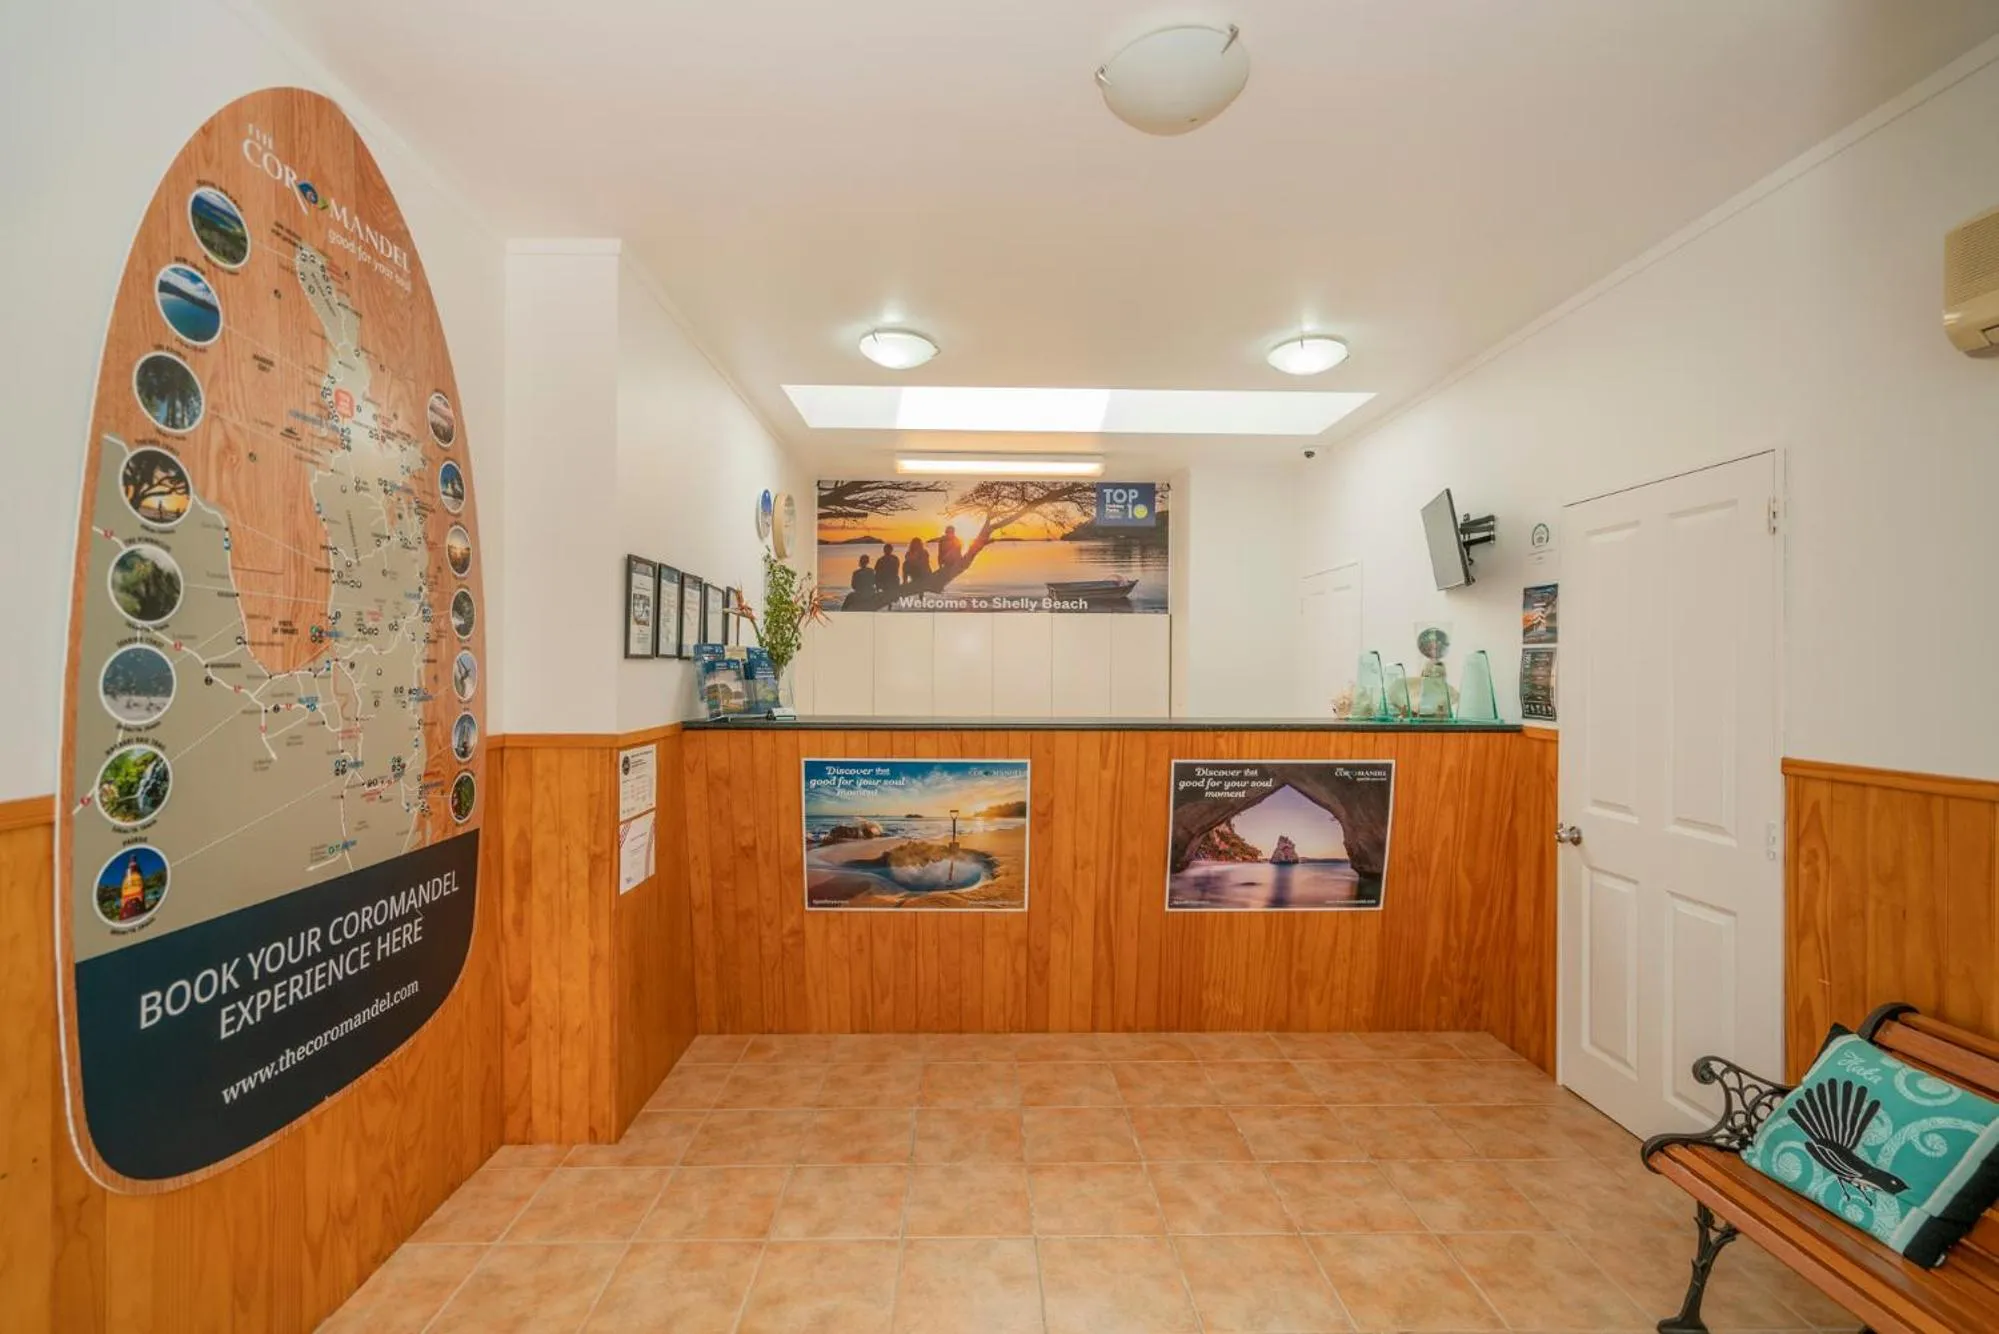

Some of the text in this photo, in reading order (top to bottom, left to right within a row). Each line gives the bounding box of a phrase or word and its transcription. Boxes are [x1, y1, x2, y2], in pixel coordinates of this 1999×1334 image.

[328, 229, 356, 254] good
[357, 246, 372, 264] for
[1103, 488, 1139, 503] TOP
[900, 595, 1088, 611] Welcome to Shelly Beach
[825, 766, 873, 775] Discover
[1194, 767, 1242, 776] Discover
[809, 776, 906, 788] good for your soul
[1178, 777, 1273, 791] good for your soul
[1205, 790, 1246, 798] moment
[139, 870, 460, 1031] BOOK YOUR COROMANDEL
[219, 917, 424, 1041] EXPERIENCE HERE
[221, 978, 419, 1105] www.thecoromandel.com
